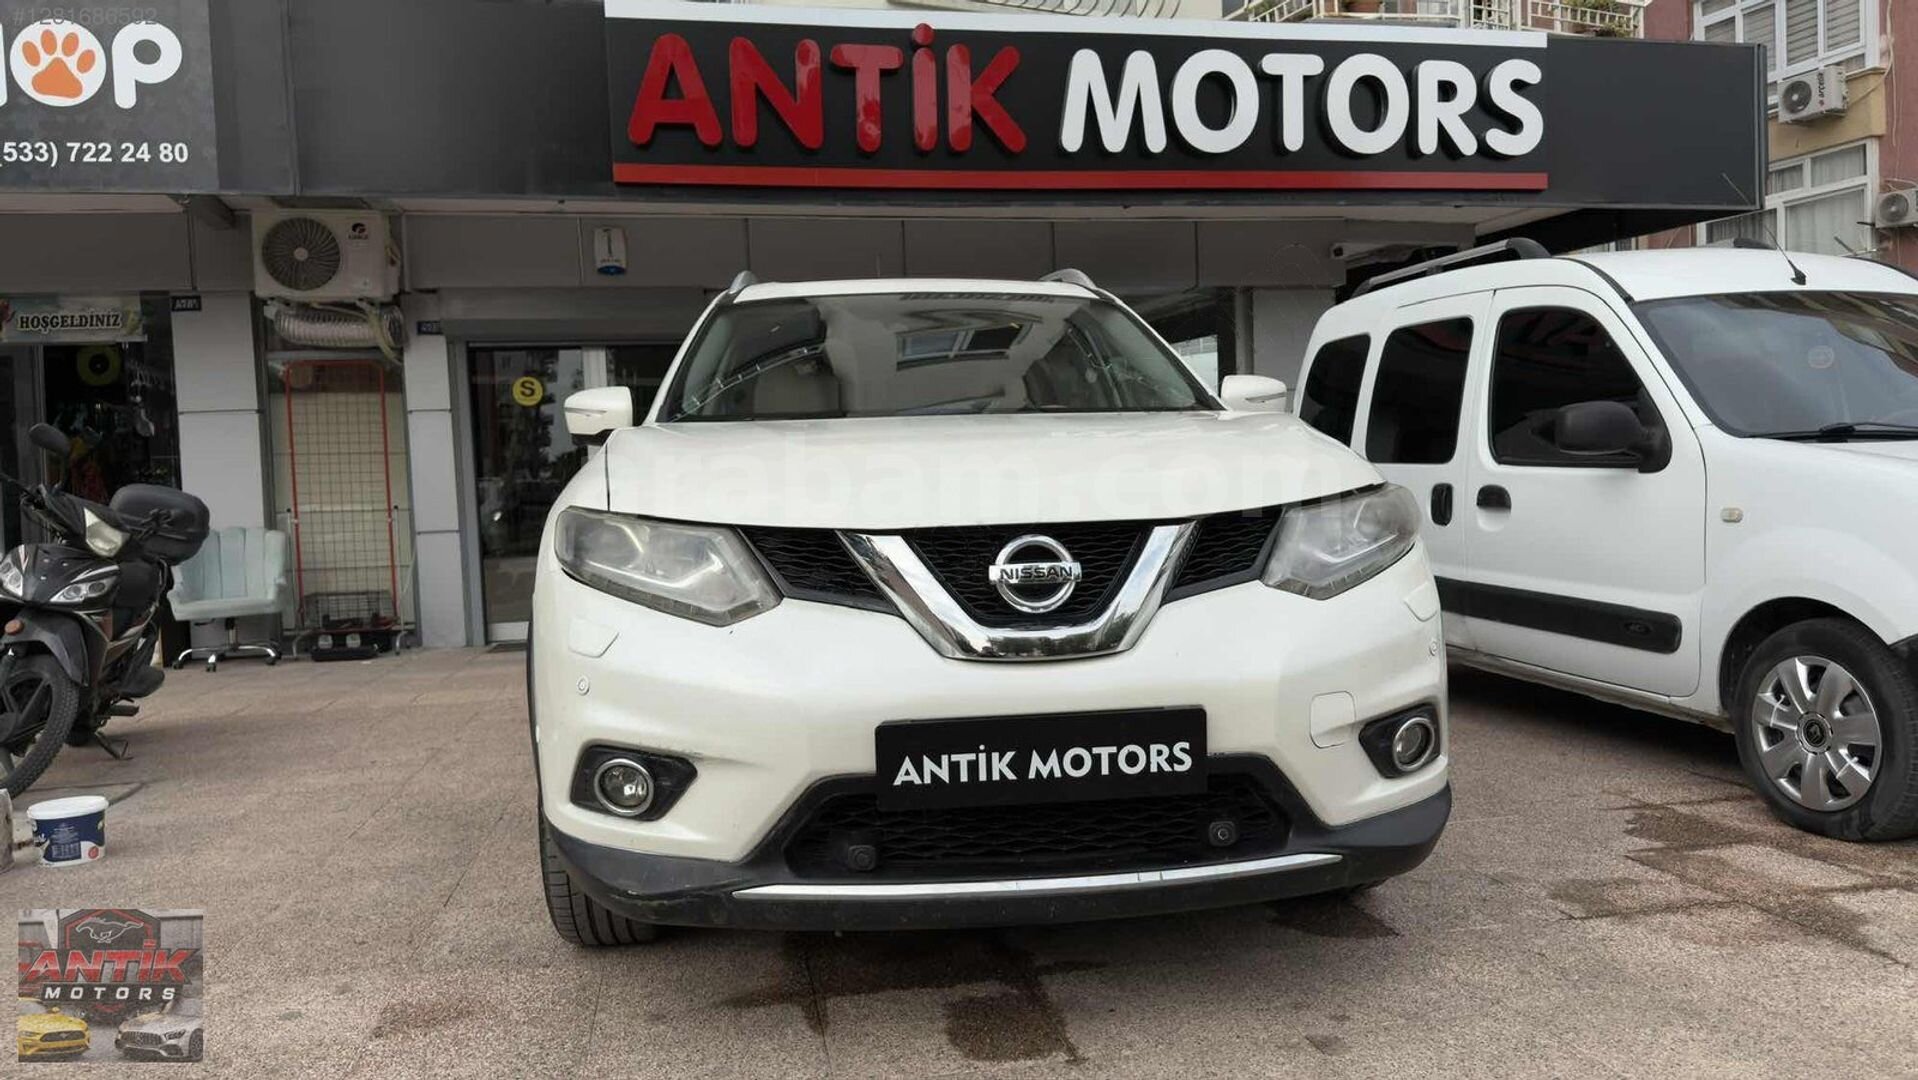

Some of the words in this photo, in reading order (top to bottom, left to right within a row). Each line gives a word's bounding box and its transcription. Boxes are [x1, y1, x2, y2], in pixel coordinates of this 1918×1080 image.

[627, 23, 1027, 153] ANTİK
[1061, 48, 1544, 156] MOTORS
[66, 142, 112, 162] 722
[121, 142, 151, 162] 24
[159, 142, 188, 163] 80
[19, 310, 123, 333] HOŞGELDİNİZ
[520, 380, 536, 397] S
[1000, 566, 1073, 580] NISSAN
[893, 744, 1018, 786] ANTİK
[1028, 742, 1193, 780] MOTORS
